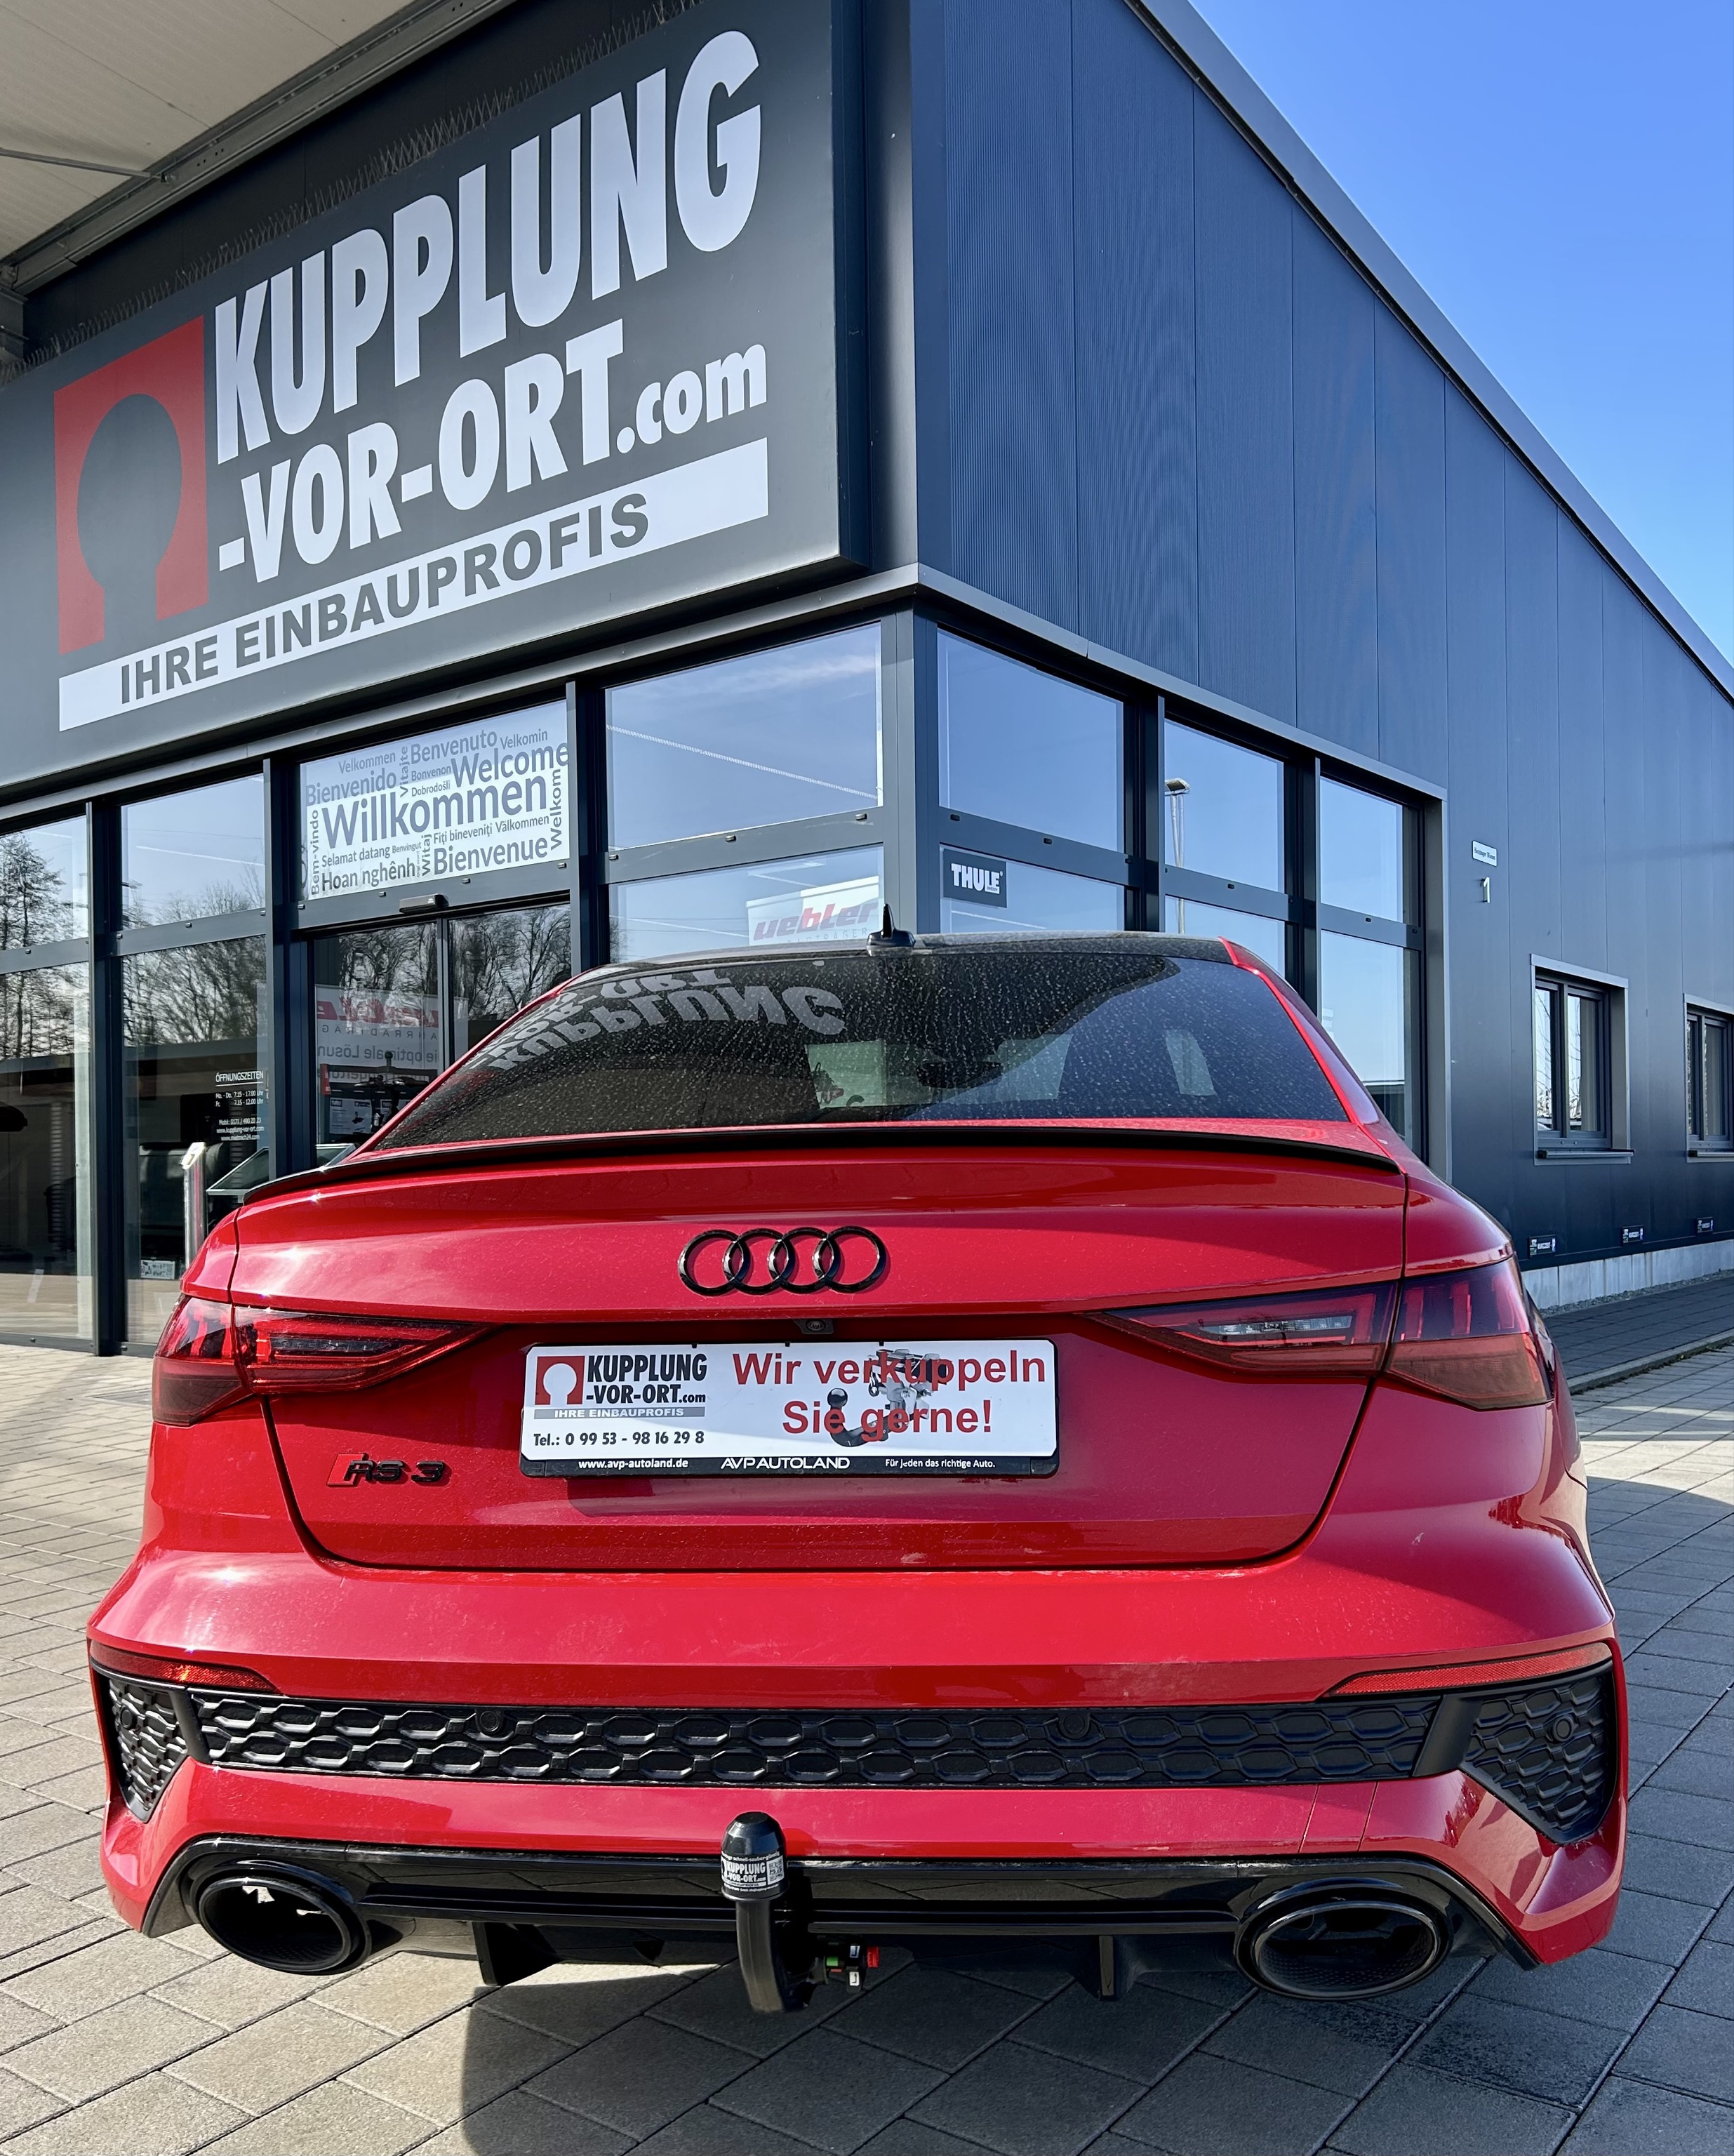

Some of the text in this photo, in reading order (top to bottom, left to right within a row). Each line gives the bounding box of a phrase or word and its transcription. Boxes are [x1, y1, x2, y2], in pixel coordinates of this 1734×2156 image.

[215, 30, 761, 464] KUPPLUNG
[219, 318, 767, 583] -VOR-ORT.com
[120, 492, 649, 704] IHRE EINBAUPROFIS
[411, 729, 497, 764] Benvenuto
[500, 728, 547, 750] Velkomin
[338, 752, 396, 774] Velkommen
[399, 746, 410, 798] Vitajte
[411, 765, 451, 781] Bonvenon
[451, 743, 568, 787] Welcome
[306, 767, 396, 806] Bienvenido
[411, 780, 451, 797] Dobrodošli
[321, 776, 546, 849] Willkommen
[550, 769, 562, 851] Welkom
[310, 810, 319, 895] Bem-vindo
[322, 846, 390, 867] Selamat datang
[422, 834, 432, 876] Witaj
[434, 837, 547, 875] Bienvenue
[322, 858, 415, 891] Hoan nghênh
[951, 863, 1000, 895] THULE
[1483, 877, 1490, 903] 1
[215, 1070, 264, 1082] ÖFFNUNGSZEITEN
[587, 1353, 707, 1383] KUPPLUNG
[733, 1350, 1046, 1391] Wir verkuppeln
[586, 1384, 706, 1404] -VOR-ORT.com
[554, 1408, 684, 1418] IHRE EINBAUPROFIS
[782, 1399, 992, 1442] Sie gerne!
[533, 1433, 560, 1446] Tel.:
[565, 1433, 575, 1446] 0
[580, 1432, 597, 1446] 99
[602, 1432, 618, 1445] 53
[632, 1432, 651, 1444] 98
[655, 1431, 669, 1444] 16
[674, 1431, 691, 1444] 29
[695, 1430, 705, 1444] 8
[578, 1458, 688, 1471] www.avp-autoland.de
[885, 1458, 899, 1468] Für
[926, 1458, 940, 1468] das
[941, 1458, 971, 1470] richtige
[973, 1459, 996, 1468] Auto.
[726, 1861, 766, 1875] KUPPLUNG
